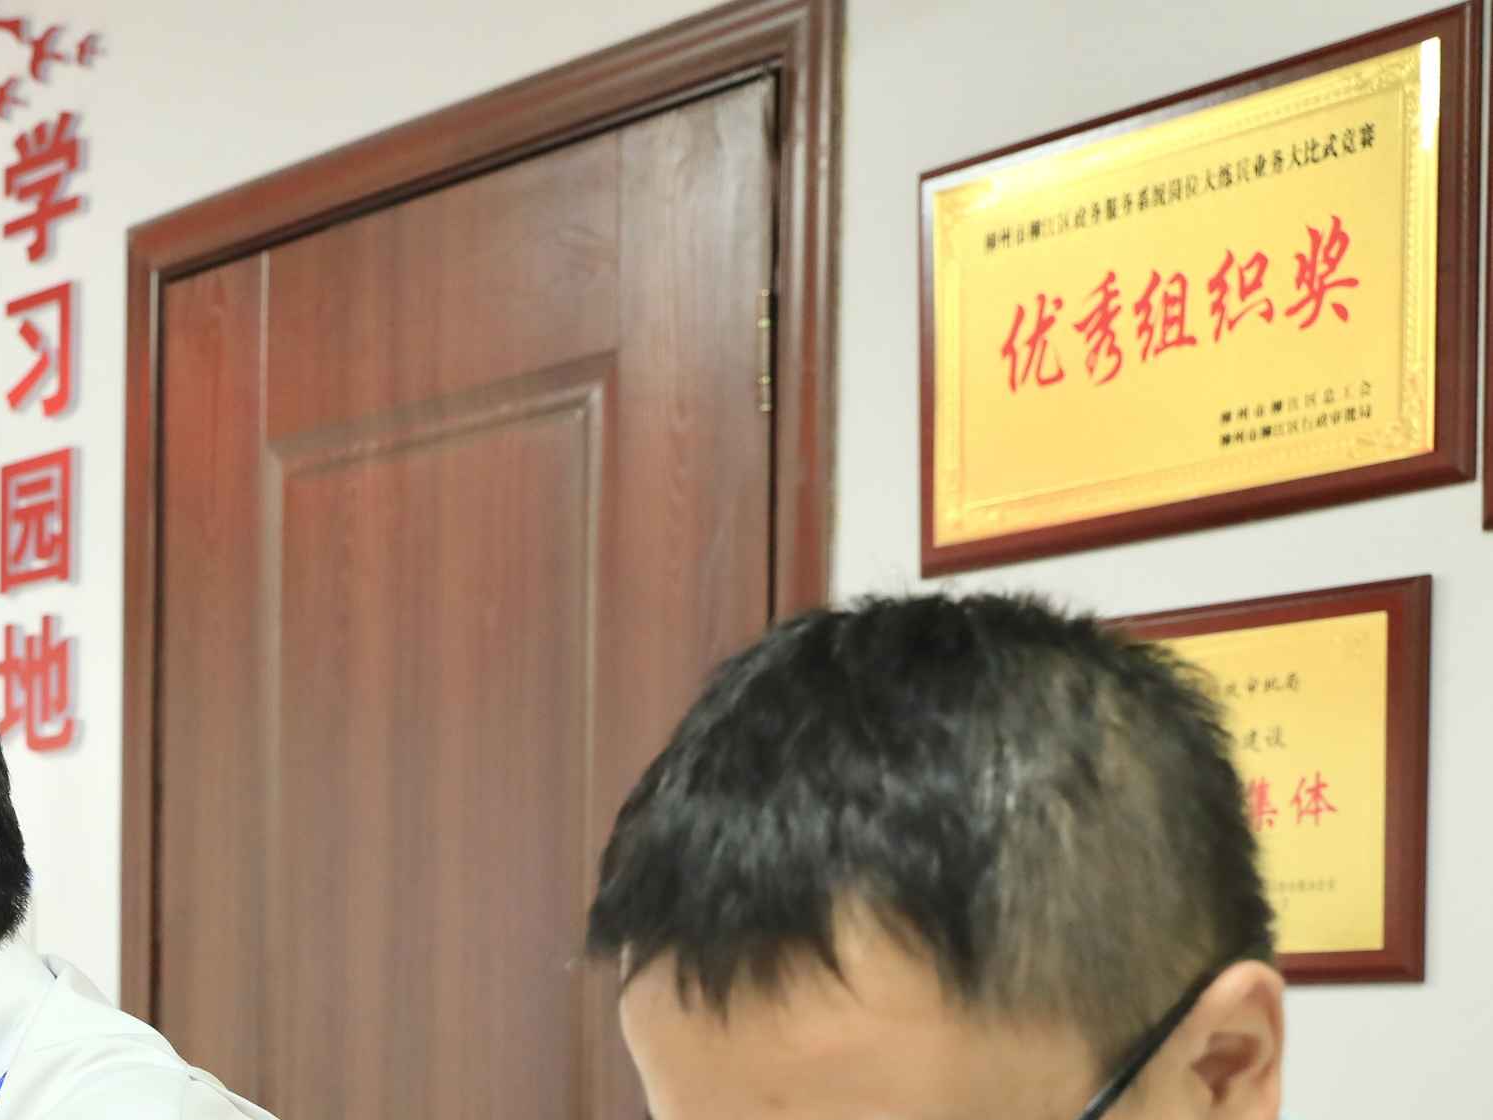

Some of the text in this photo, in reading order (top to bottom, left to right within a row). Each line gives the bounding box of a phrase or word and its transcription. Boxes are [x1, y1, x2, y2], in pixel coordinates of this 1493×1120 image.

[1000, 214, 1360, 394] 优秀组织奖
[1244, 771, 1339, 832] 集体
